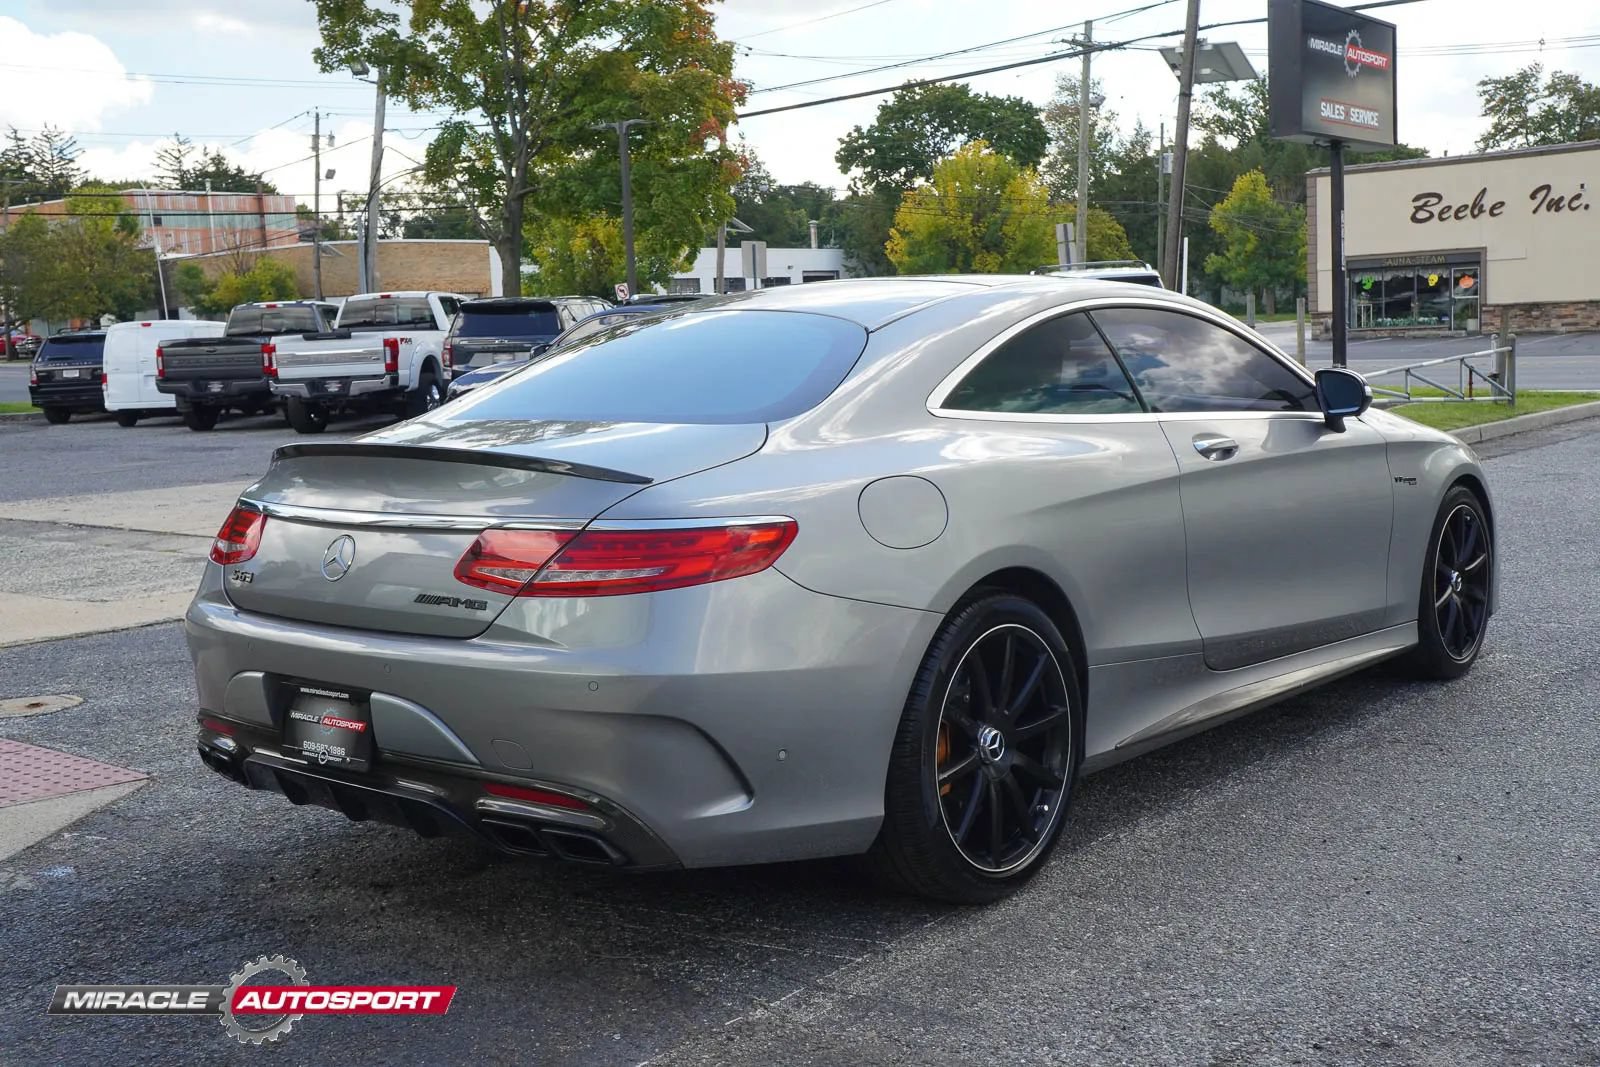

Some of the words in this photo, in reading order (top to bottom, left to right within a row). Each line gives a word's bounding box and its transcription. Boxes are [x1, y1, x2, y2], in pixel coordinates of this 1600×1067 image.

[1309, 37, 1343, 56] MIRACLE
[1347, 47, 1387, 68] AUTOSPORT
[1320, 101, 1345, 120] SALES
[1349, 107, 1379, 126] SERVICE
[1410, 186, 1506, 224] Beebe
[1529, 183, 1590, 215] Inc.
[231, 569, 254, 584] S63
[290, 711, 320, 723] MIRACLE
[322, 717, 364, 731] AUTOSPORT
